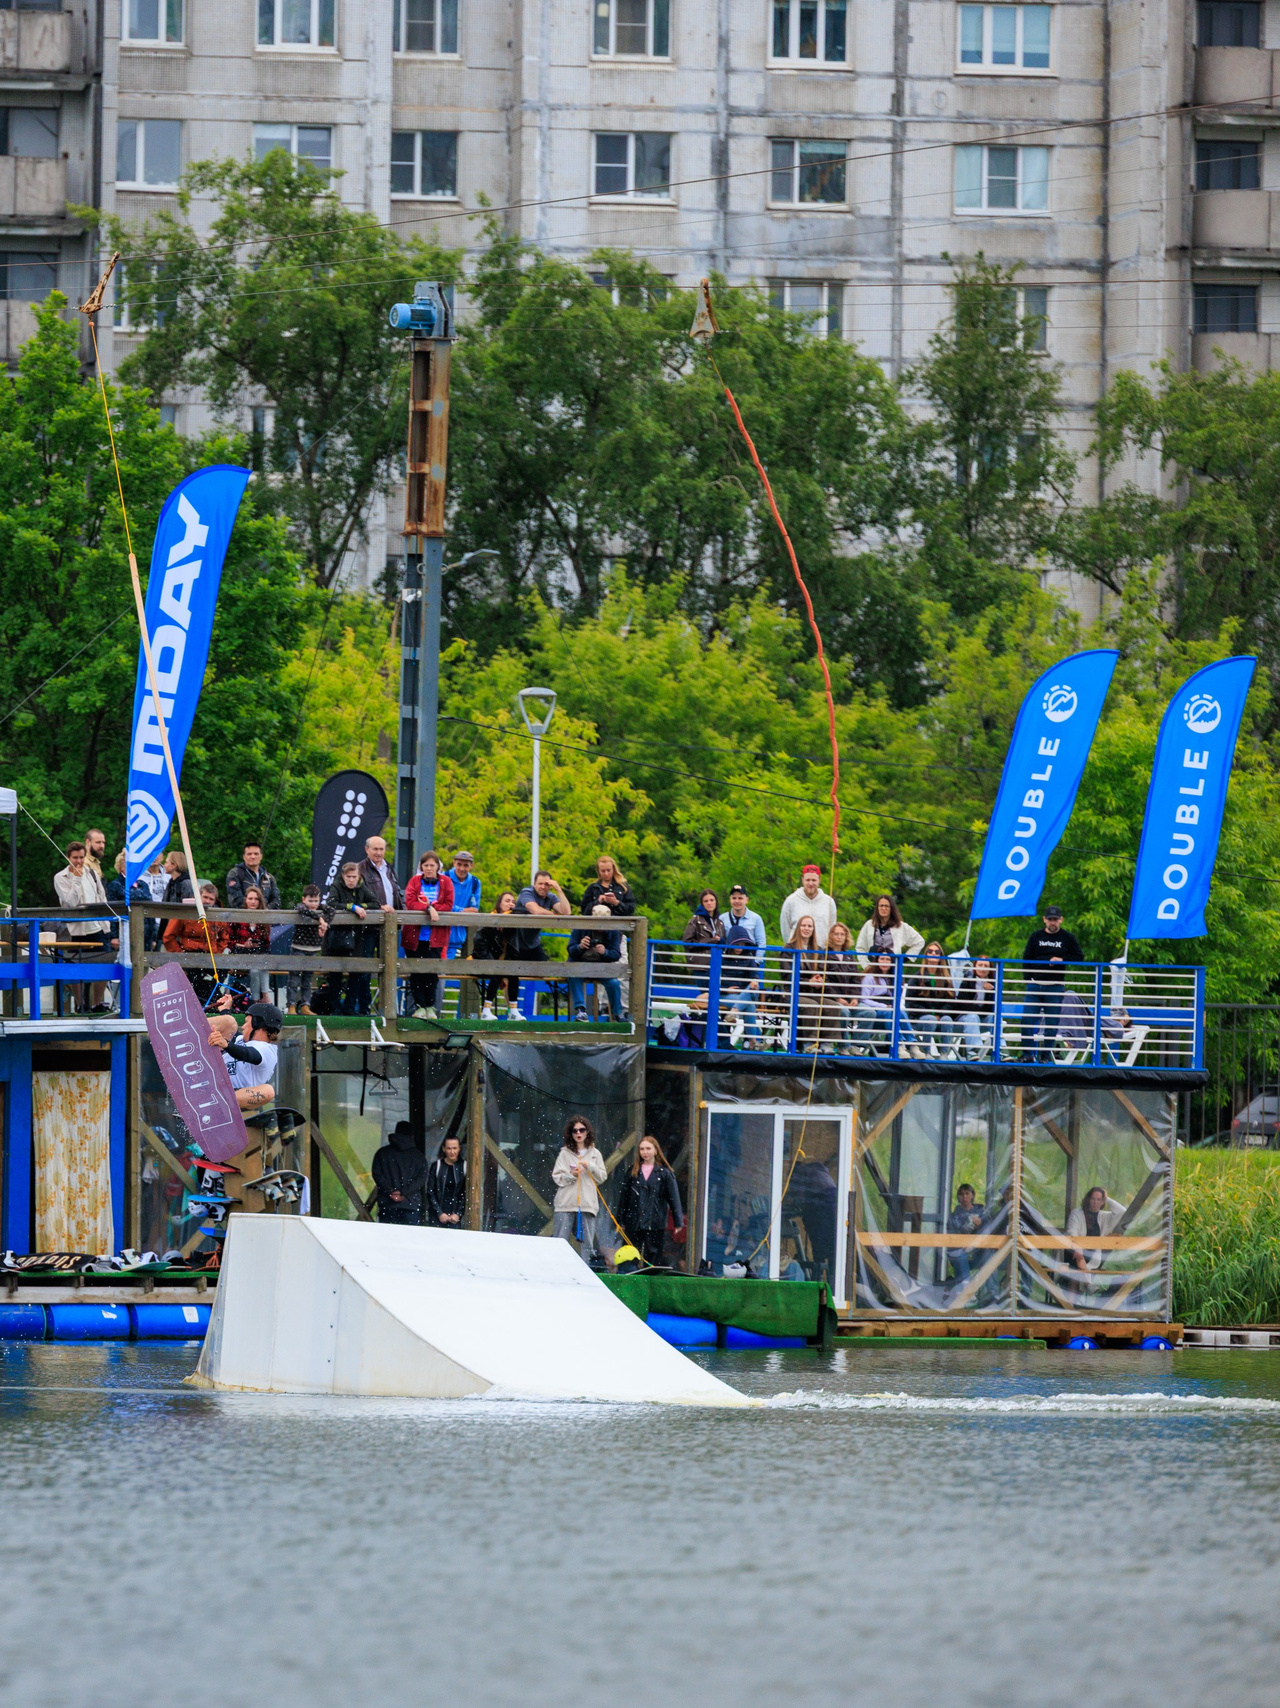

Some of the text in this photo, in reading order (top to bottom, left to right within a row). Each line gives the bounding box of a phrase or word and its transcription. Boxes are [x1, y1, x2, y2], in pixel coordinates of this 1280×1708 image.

[324, 844, 346, 886] ZONE
[998, 736, 1061, 900] DOUBLE
[1156, 748, 1209, 920] DOUBLE
[157, 996, 182, 1009] FORCE
[163, 1008, 219, 1109] LIQUID
